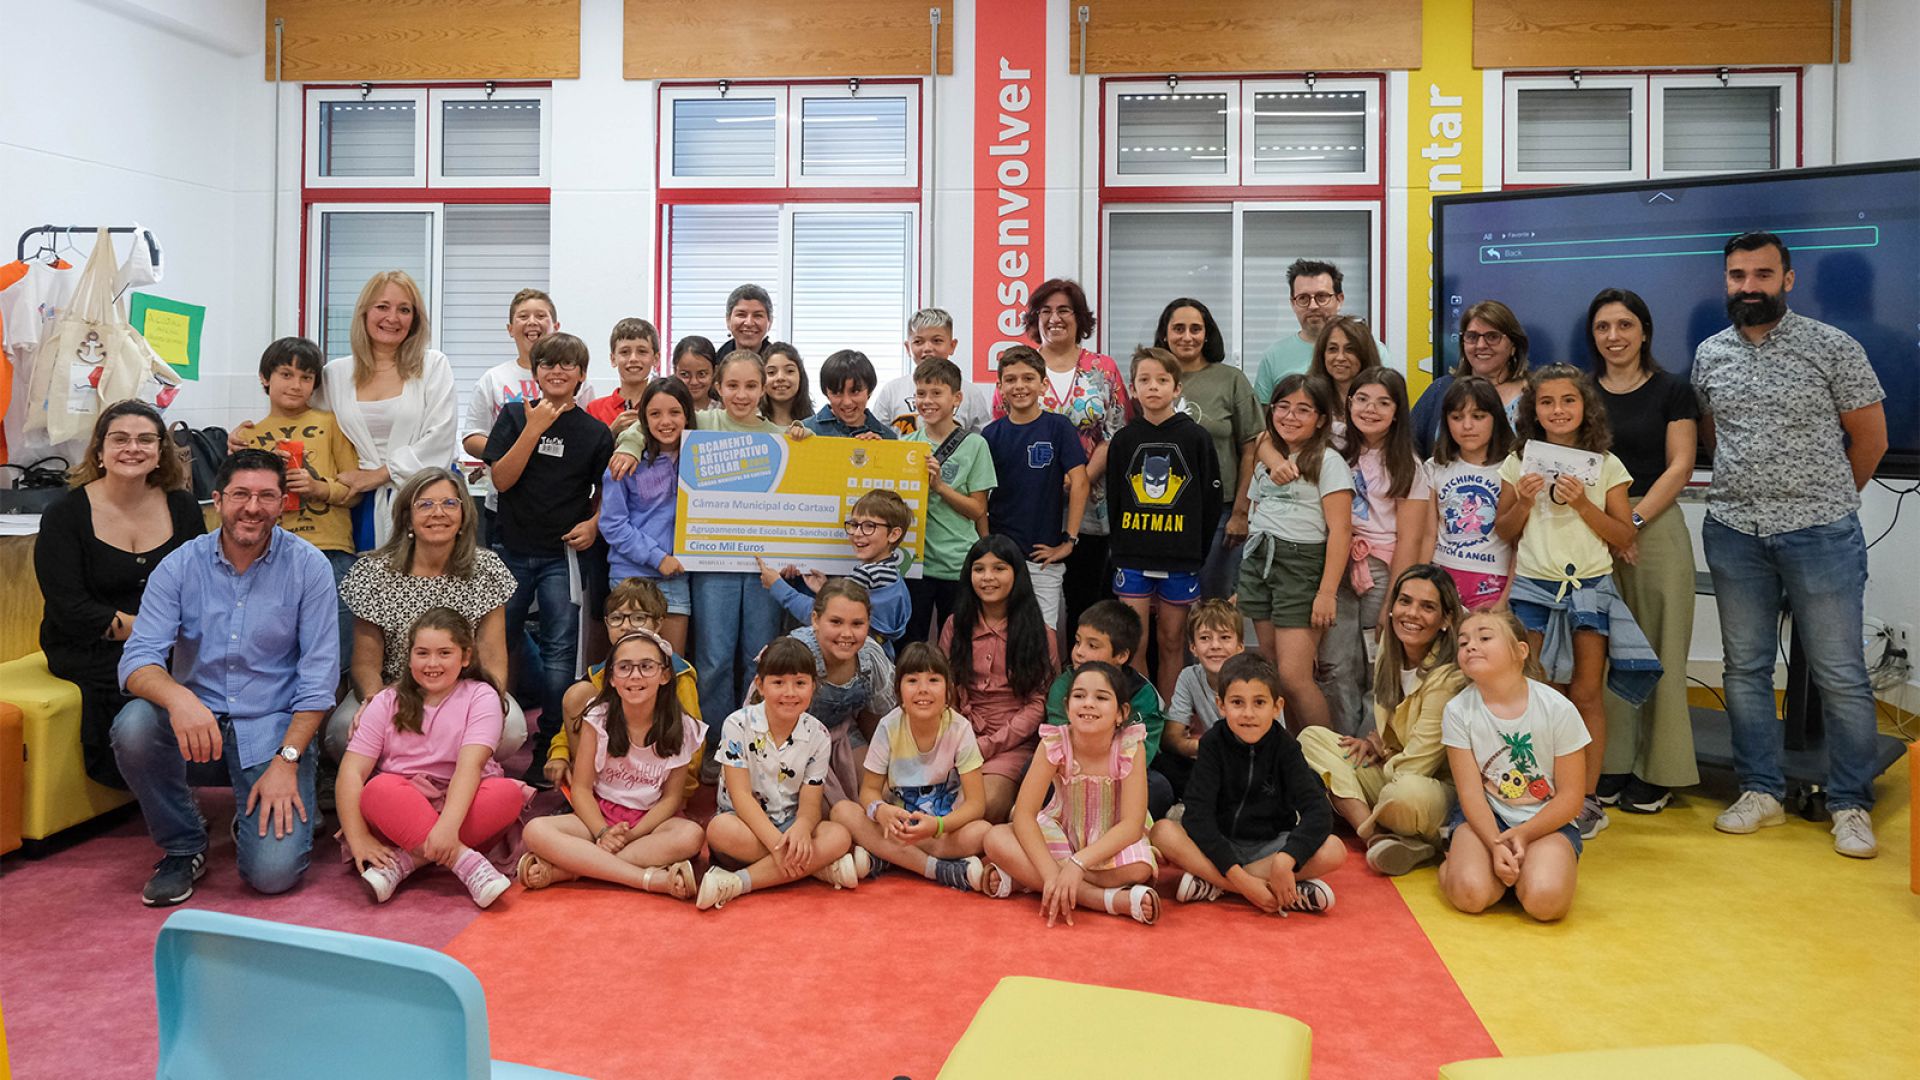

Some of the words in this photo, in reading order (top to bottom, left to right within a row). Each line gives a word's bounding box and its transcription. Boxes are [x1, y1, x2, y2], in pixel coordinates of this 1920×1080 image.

[1482, 233, 1493, 241] All
[1504, 248, 1523, 258] Back
[691, 434, 754, 456] ORÇAMENTO
[693, 443, 769, 466] PARTICIPATIVO
[1439, 475, 1483, 500] CATCHING
[692, 498, 730, 509] Câmara
[732, 499, 781, 511] Municipal
[783, 501, 795, 511] do
[798, 502, 835, 513] Cartaxo
[1121, 511, 1184, 532] BATMAN
[690, 525, 746, 536] Agrupamento
[747, 527, 758, 535] de
[759, 527, 788, 536] Escolas
[800, 528, 828, 537] Sancho
[834, 529, 844, 538] de
[689, 541, 717, 552] Cinco
[719, 541, 736, 552] Mil
[737, 542, 765, 552] Euros
[1435, 543, 1457, 558] TITCH
[1457, 551, 1464, 559] &
[1464, 551, 1496, 563] ANGEL
